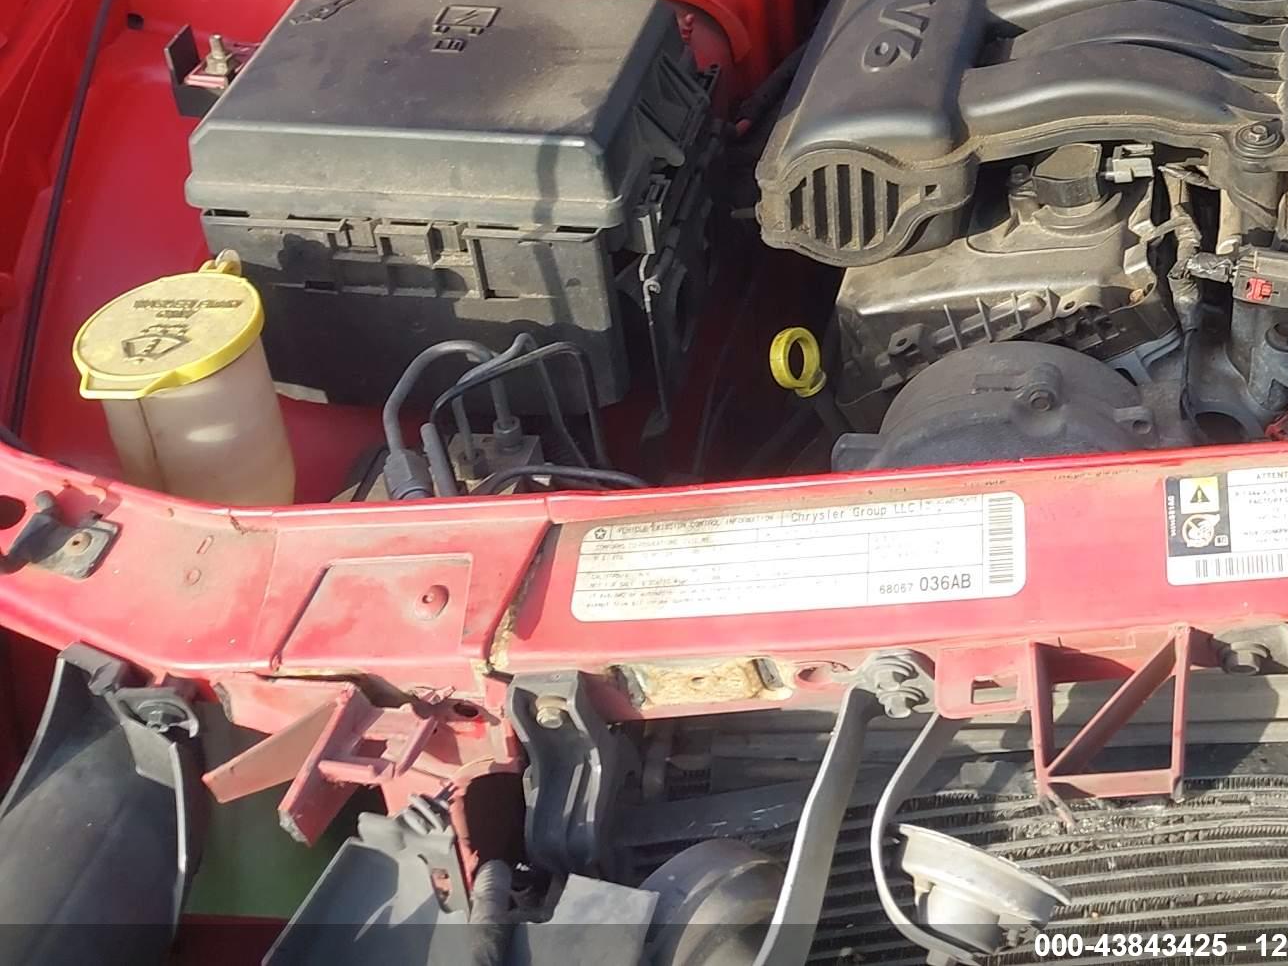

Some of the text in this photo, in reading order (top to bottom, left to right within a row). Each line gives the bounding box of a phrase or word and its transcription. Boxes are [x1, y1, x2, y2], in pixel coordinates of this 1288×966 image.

[791, 510, 845, 525] Chrysler
[852, 505, 887, 518] Group
[894, 502, 914, 514] LLC
[919, 573, 971, 592] 036AB
